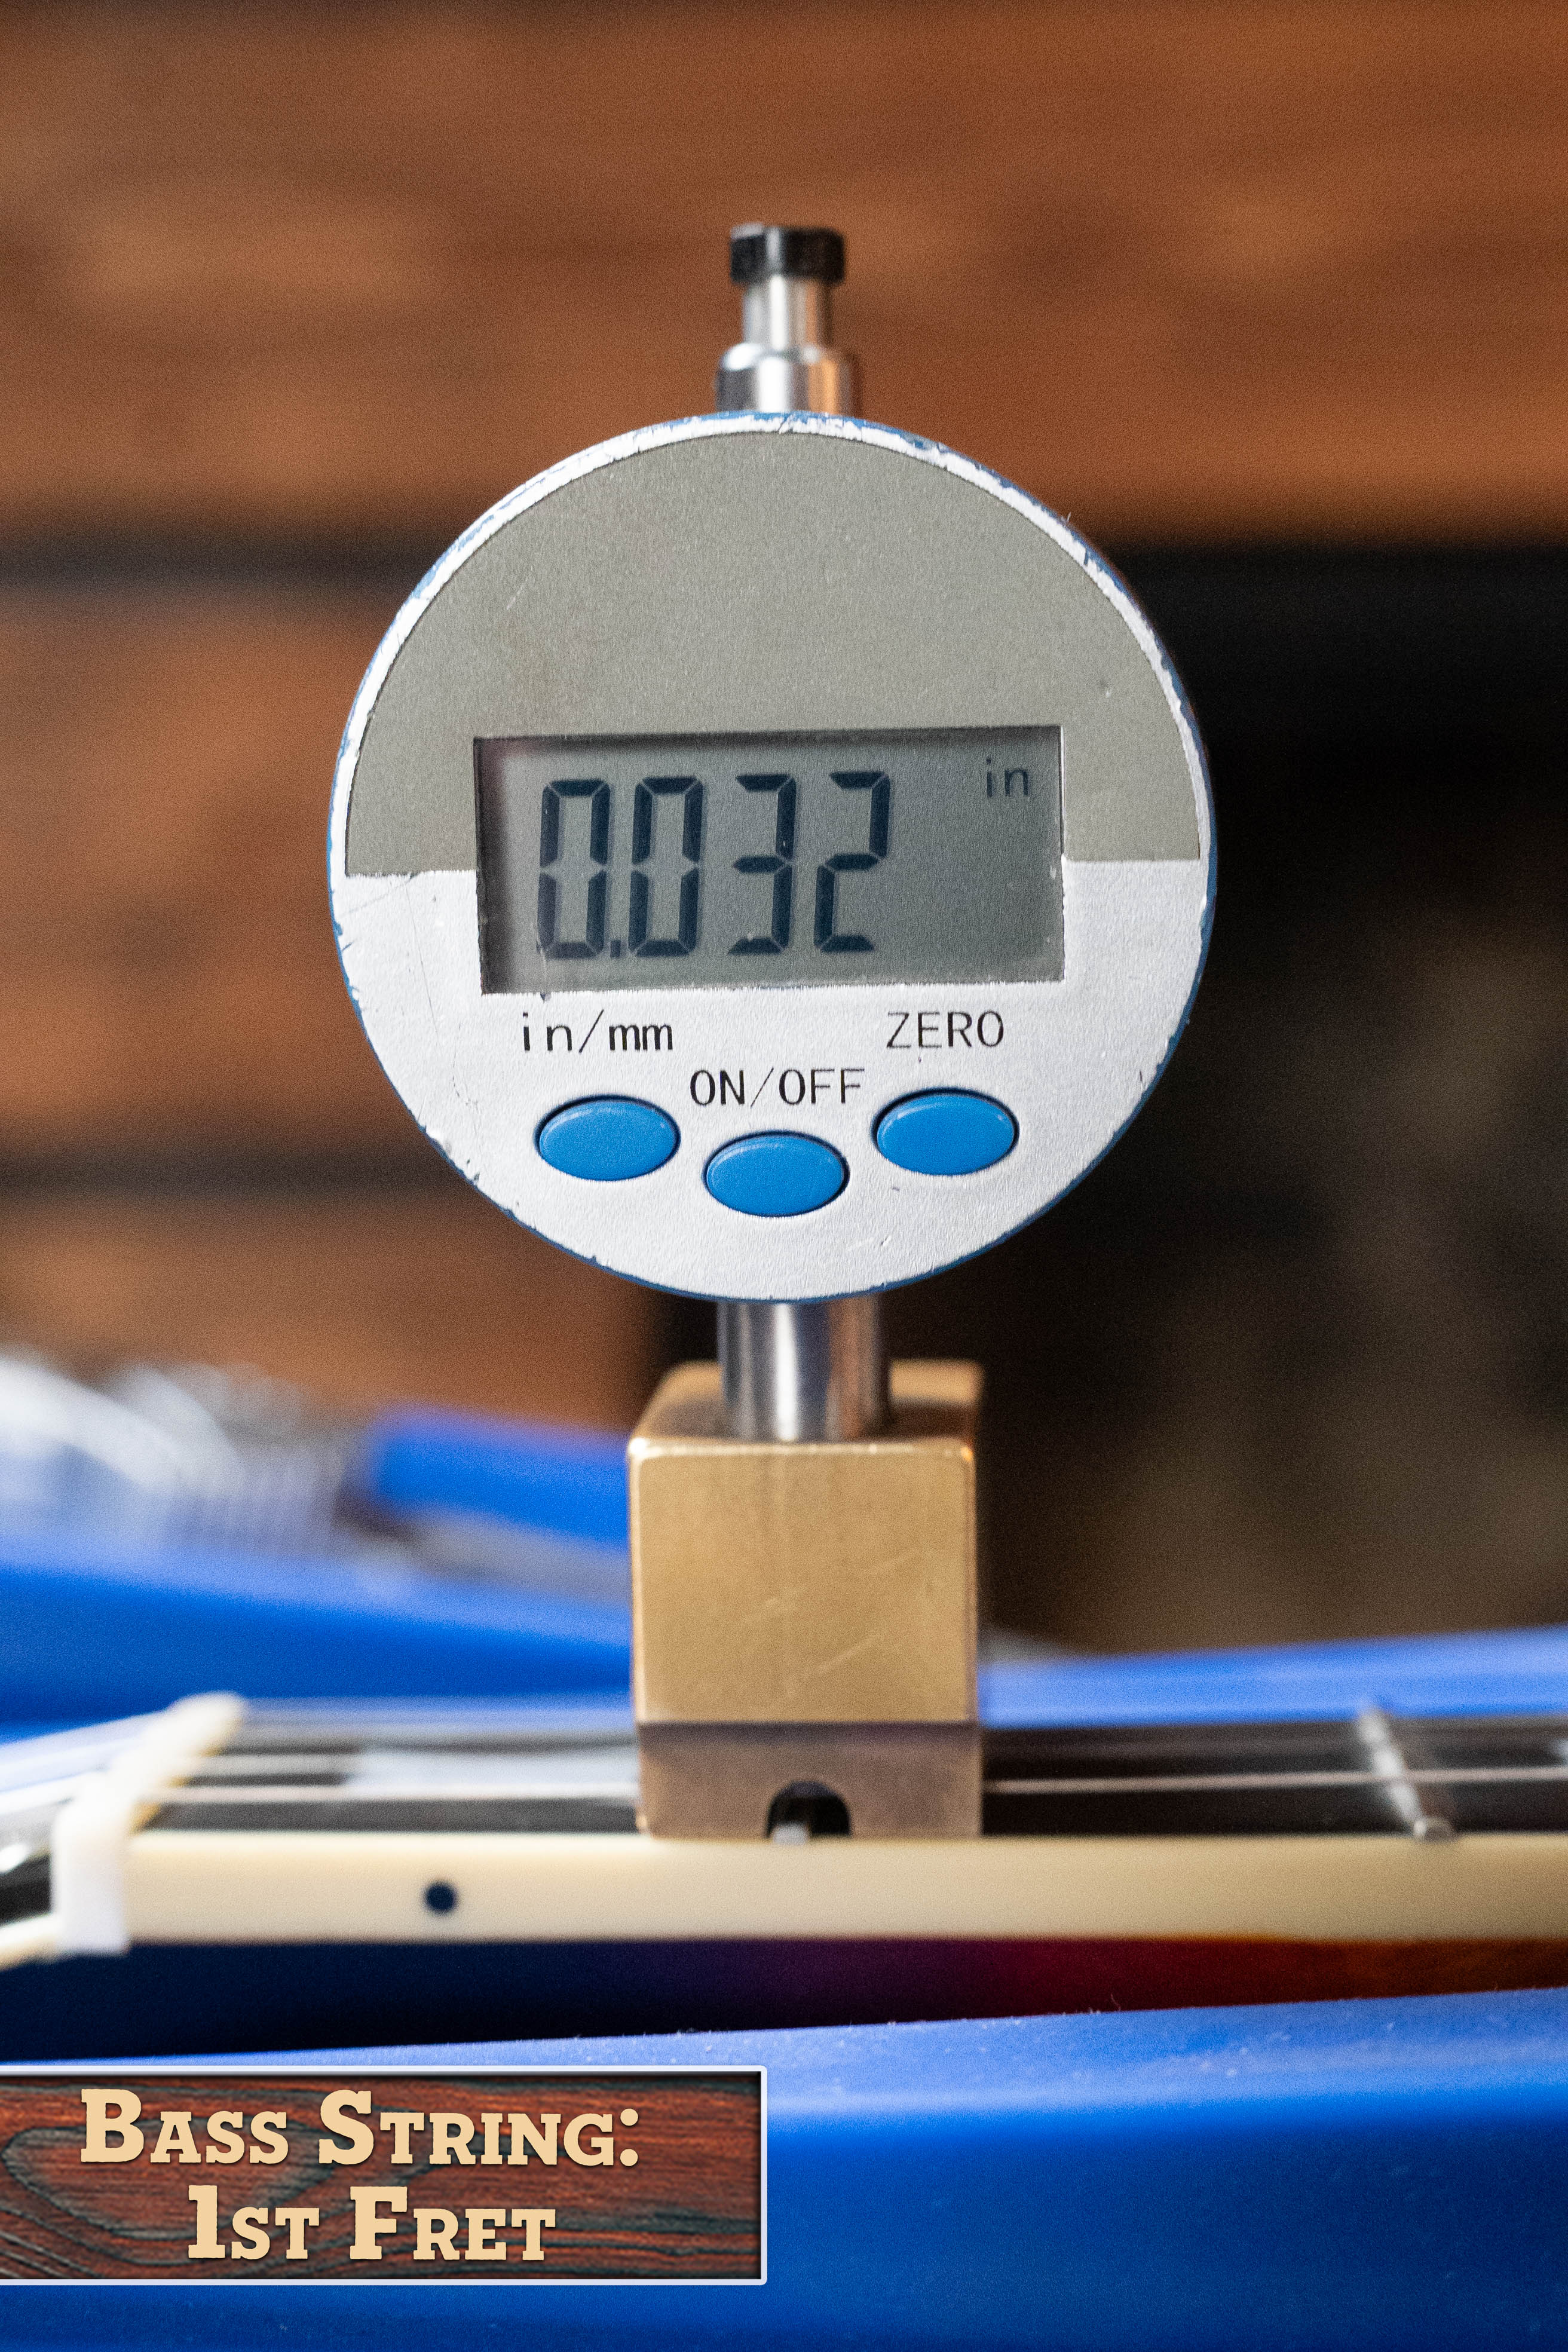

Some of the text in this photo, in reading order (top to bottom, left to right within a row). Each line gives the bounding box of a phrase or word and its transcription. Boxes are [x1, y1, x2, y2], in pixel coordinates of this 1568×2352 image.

[985, 757, 1030, 798] in
[537, 770, 890, 958] 0.032
[522, 1009, 674, 1054] in/mm
[886, 1010, 1004, 1049] ZERO
[689, 1067, 866, 1108] ON/OFF
